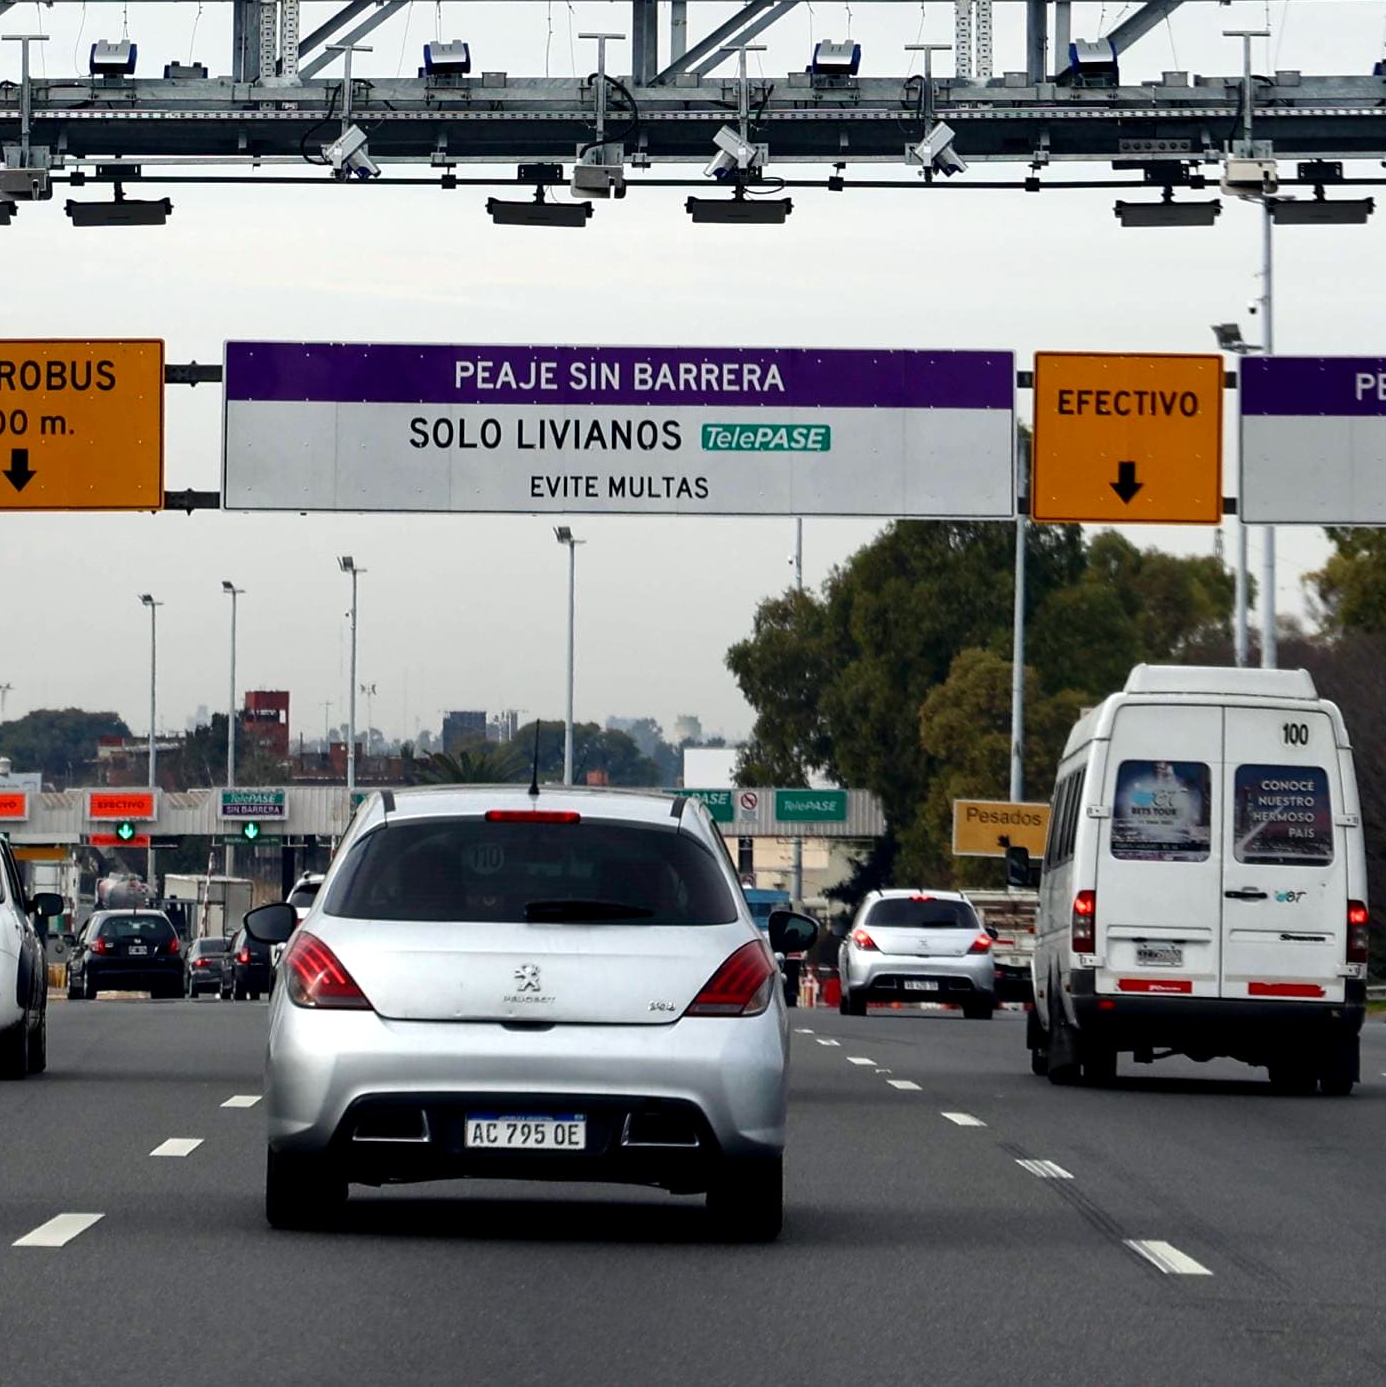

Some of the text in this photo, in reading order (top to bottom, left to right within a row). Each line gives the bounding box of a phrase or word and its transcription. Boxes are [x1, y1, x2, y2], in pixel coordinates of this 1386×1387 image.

[455, 361, 785, 392] PEAJE SIN BARRERA
[1058, 389, 1199, 417] EFECTIVO
[40, 415, 75, 436] m.
[409, 417, 826, 451] SOLO LIVIANOS TelePASE
[530, 476, 709, 499] EVITE MULTAS
[1283, 723, 1309, 745] 100
[783, 800, 837, 812] TelePASE
[1258, 796, 1314, 807] NUESTRO
[966, 806, 1042, 826] Pesados
[1253, 812, 1315, 823] HERMOSO
[473, 1123, 580, 1146] AC 795 OE
